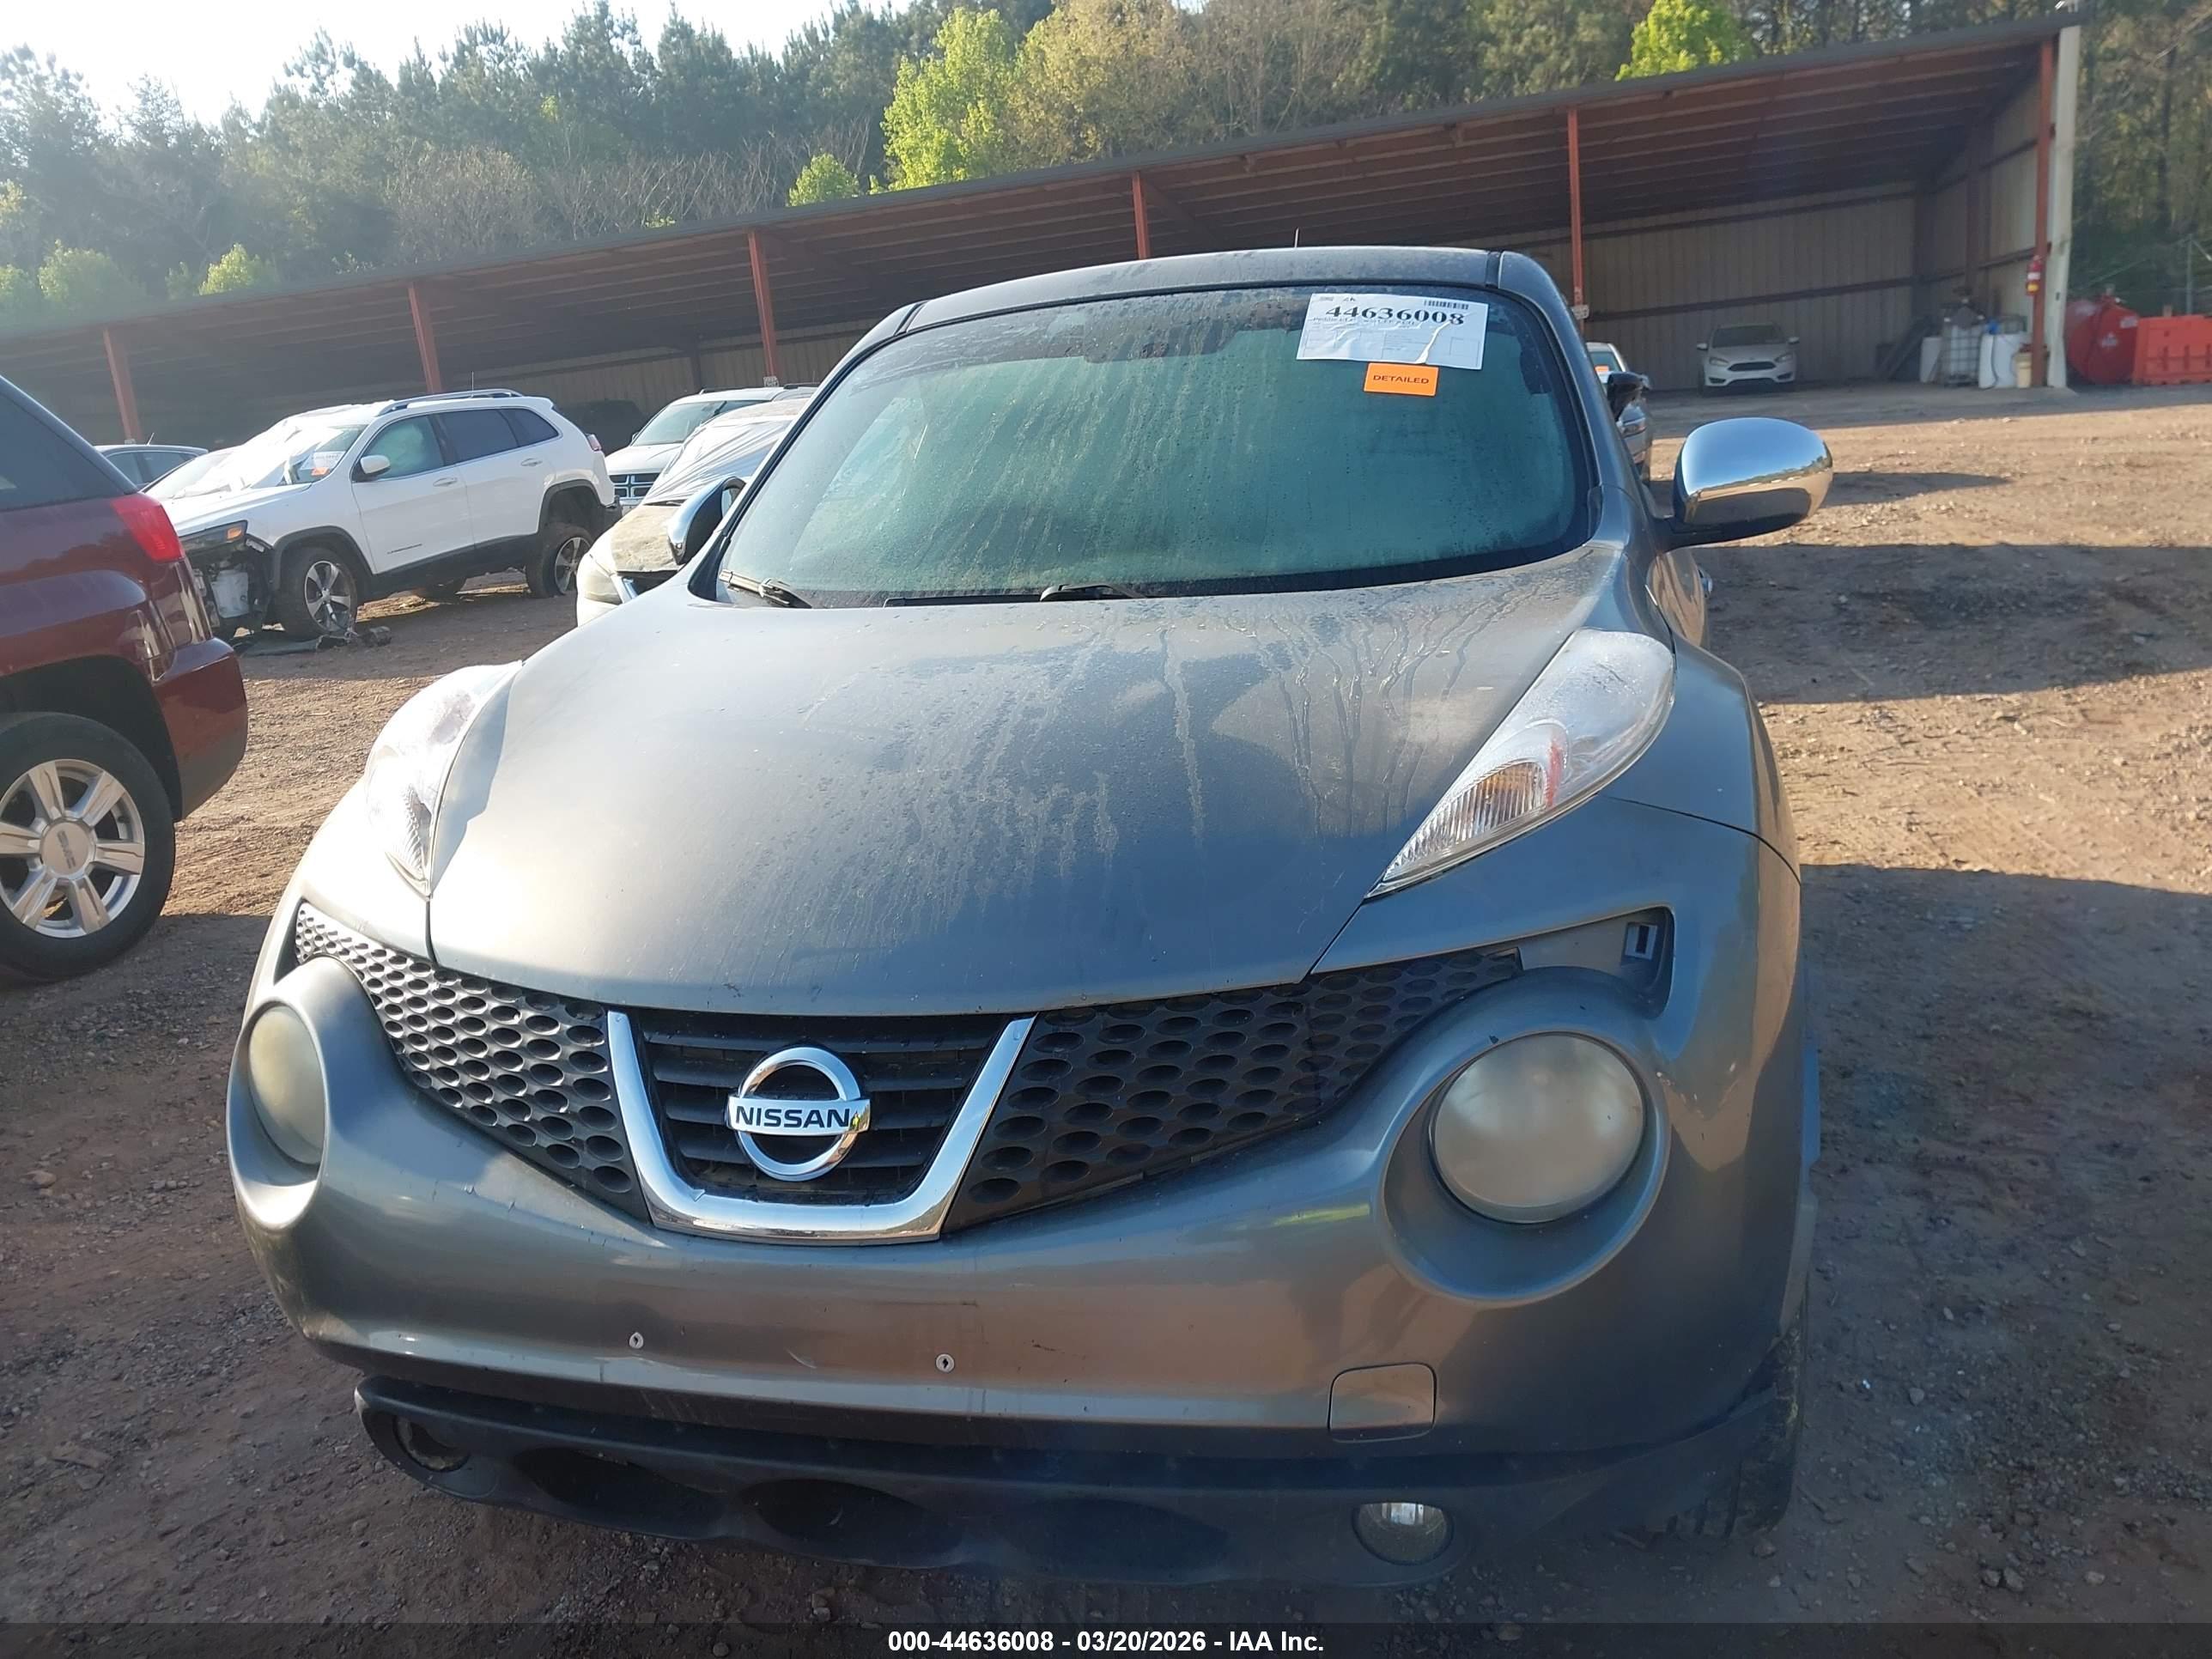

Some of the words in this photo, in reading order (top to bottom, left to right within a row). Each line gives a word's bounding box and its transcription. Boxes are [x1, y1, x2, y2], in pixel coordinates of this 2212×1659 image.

[1325, 305, 1466, 325] 44636008
[1373, 374, 1430, 385] DETAILED
[735, 1105, 851, 1129] NISSAN
